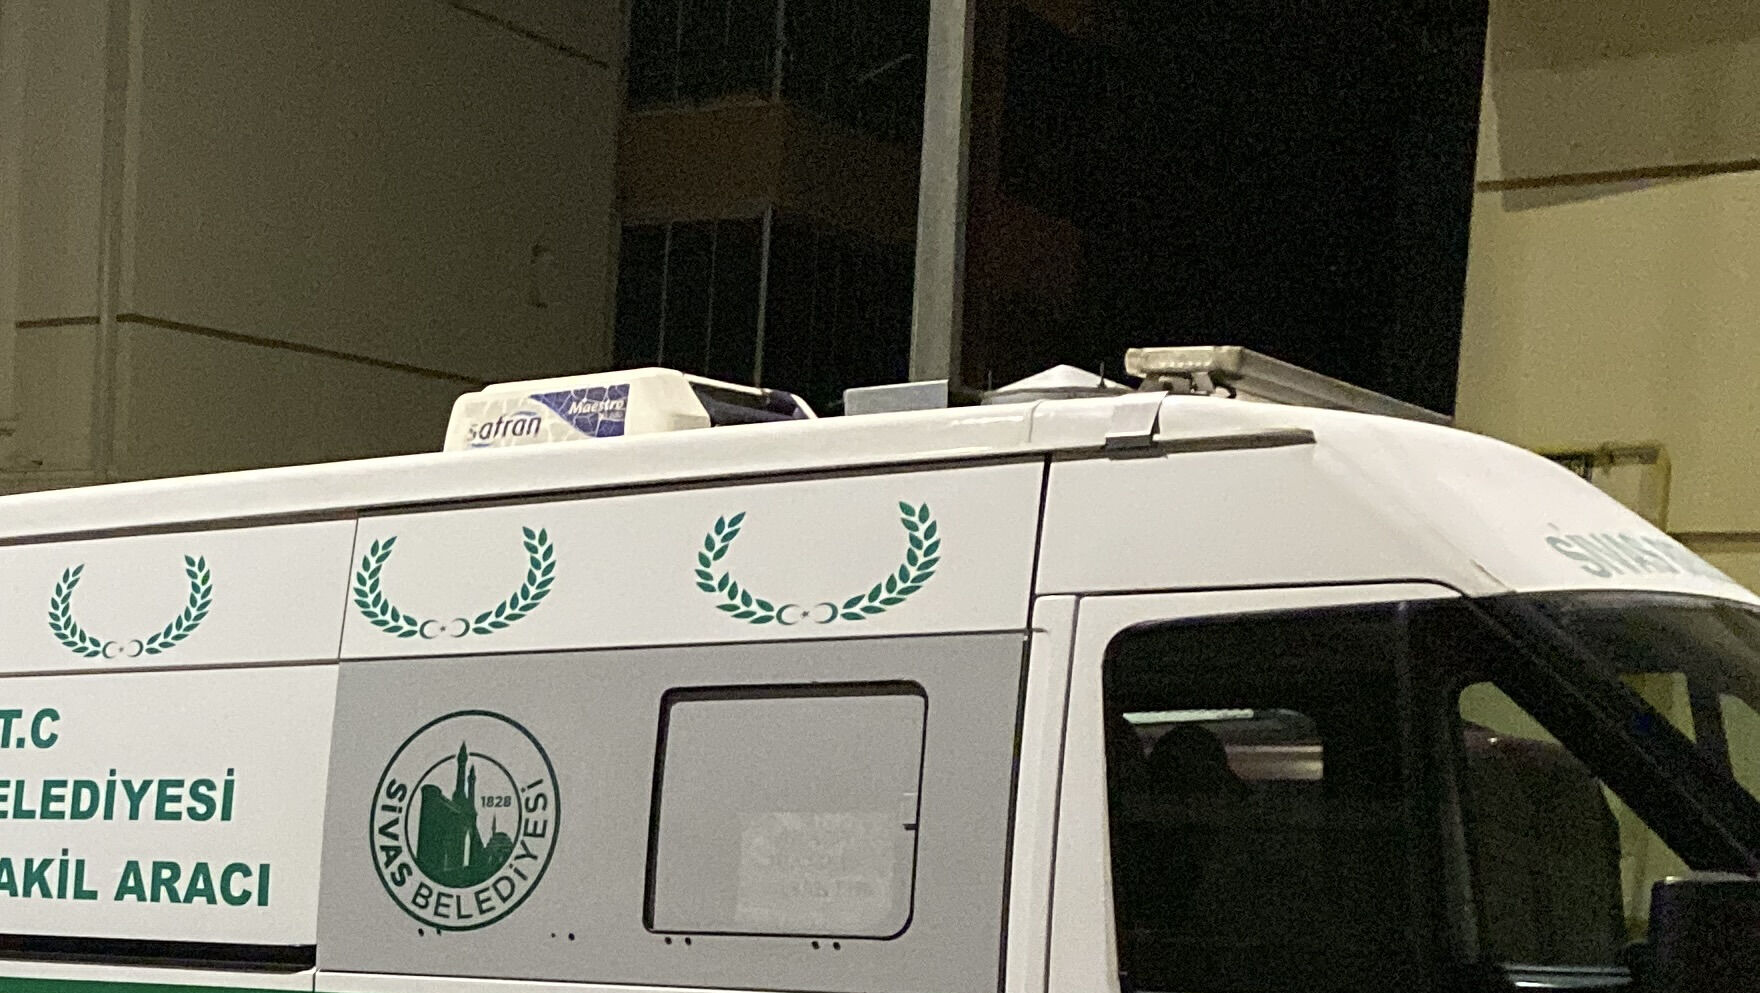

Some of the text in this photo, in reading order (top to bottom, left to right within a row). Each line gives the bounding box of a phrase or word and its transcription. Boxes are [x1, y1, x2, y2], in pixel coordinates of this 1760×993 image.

[568, 398, 625, 415] Maestro
[467, 413, 542, 443] safran
[480, 795, 512, 808] 1828
[377, 777, 548, 920] SİVAS BELEDİYESİ
[113, 859, 272, 907] ARACI
